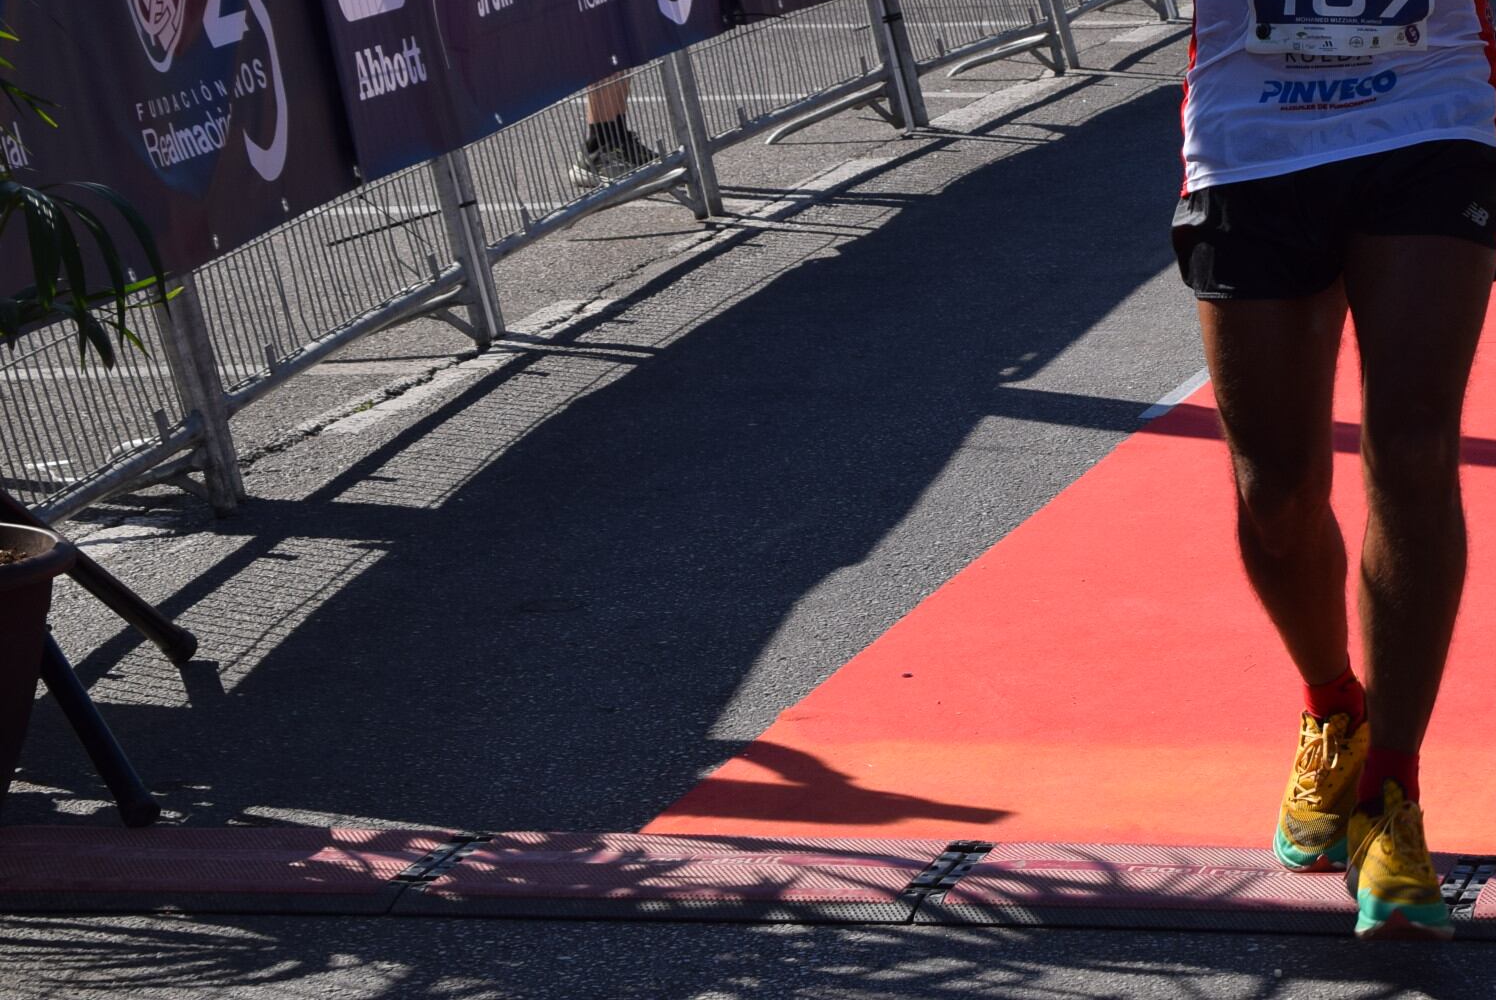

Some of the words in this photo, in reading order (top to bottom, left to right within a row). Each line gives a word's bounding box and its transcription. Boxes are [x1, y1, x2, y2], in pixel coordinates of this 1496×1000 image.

[355, 35, 427, 101] Abbott
[1259, 69, 1397, 104] PINVECO
[136, 78, 228, 122] FUNDACIÓN
